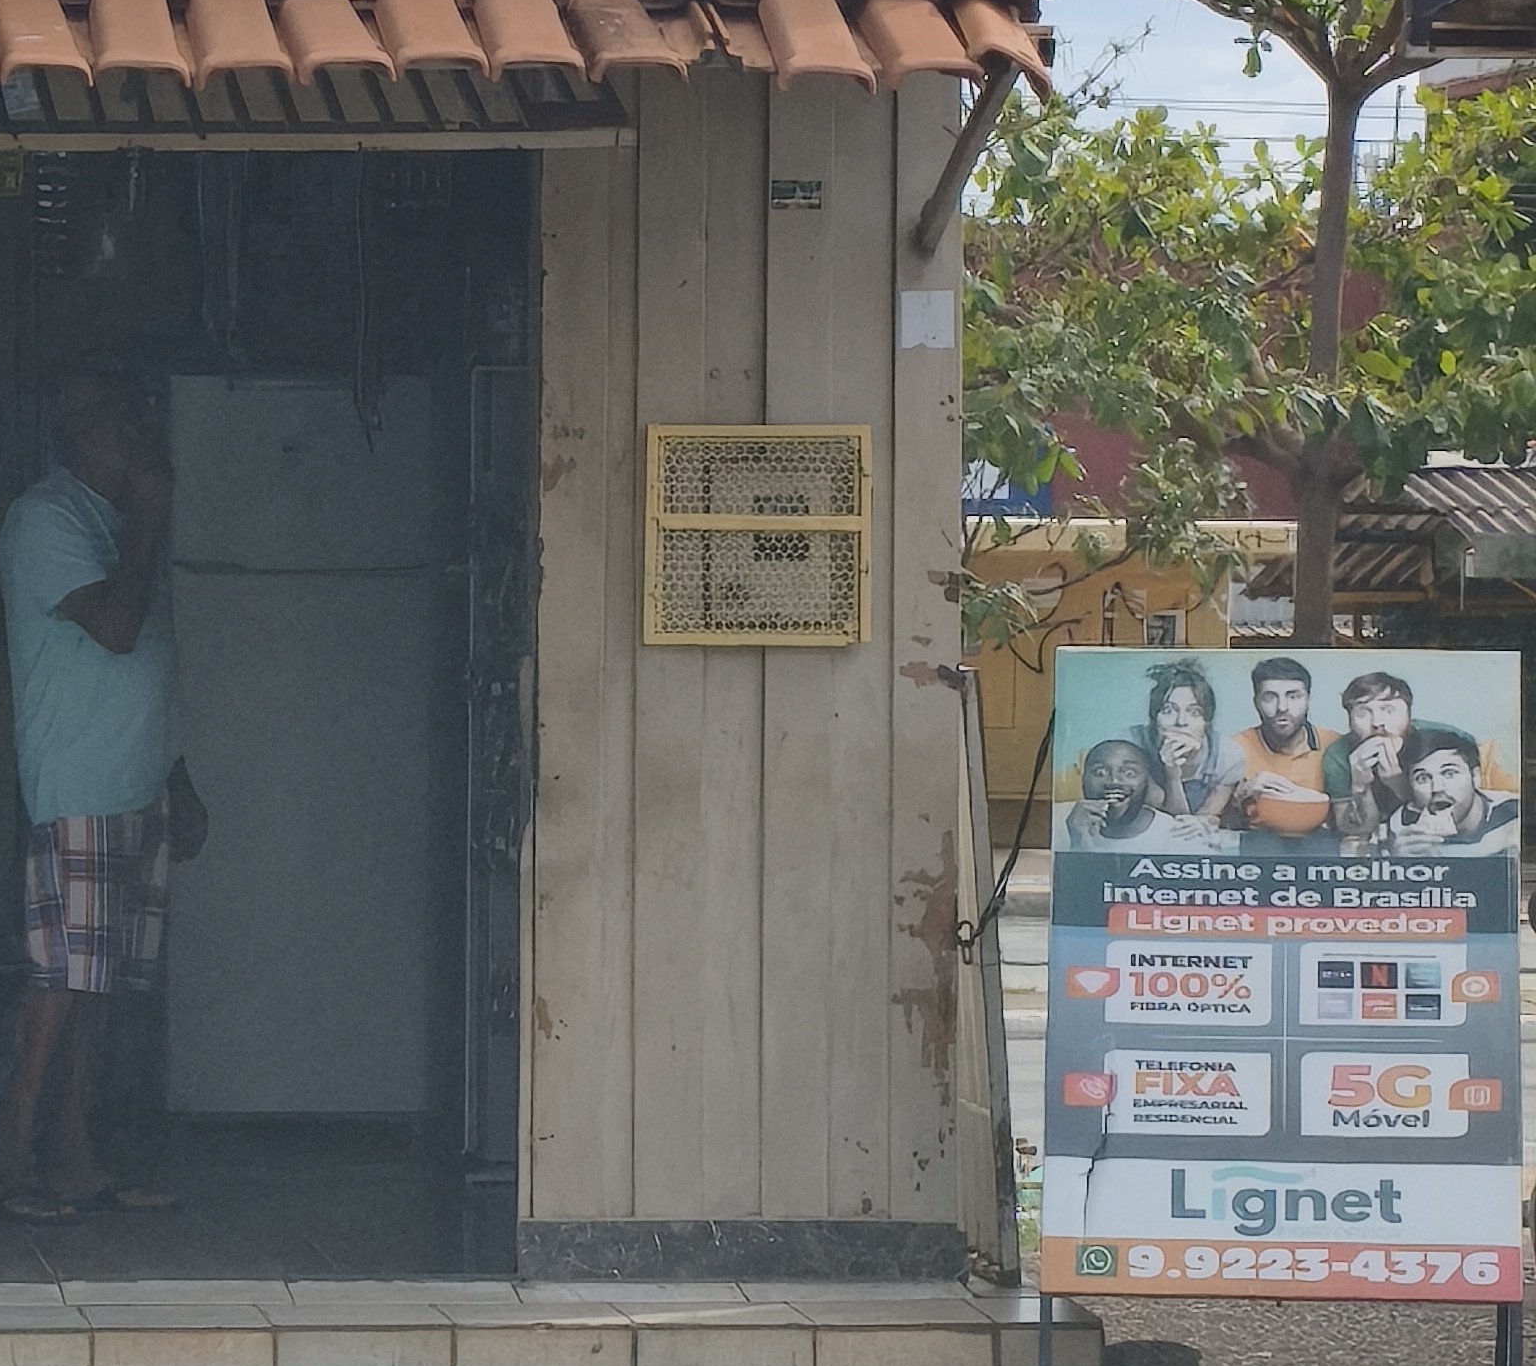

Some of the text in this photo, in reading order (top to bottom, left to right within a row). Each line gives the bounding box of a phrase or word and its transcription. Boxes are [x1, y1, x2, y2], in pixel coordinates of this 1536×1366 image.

[1129, 857, 1450, 883] Assine a melhor
[1102, 882, 1477, 909] internet de Brasília
[1127, 910, 1453, 937] Lignet provedor
[1130, 953, 1253, 970] INTERNET
[1129, 972, 1252, 1000] 100%
[1135, 1059, 1237, 1073] TELEFONIA
[1134, 1072, 1240, 1097] FIXA
[1328, 1064, 1433, 1108] 5G
[1332, 1108, 1430, 1129] Móvel
[1170, 1167, 1403, 1237] Lignet
[1127, 1245, 1501, 1286] 9.9223-4376
